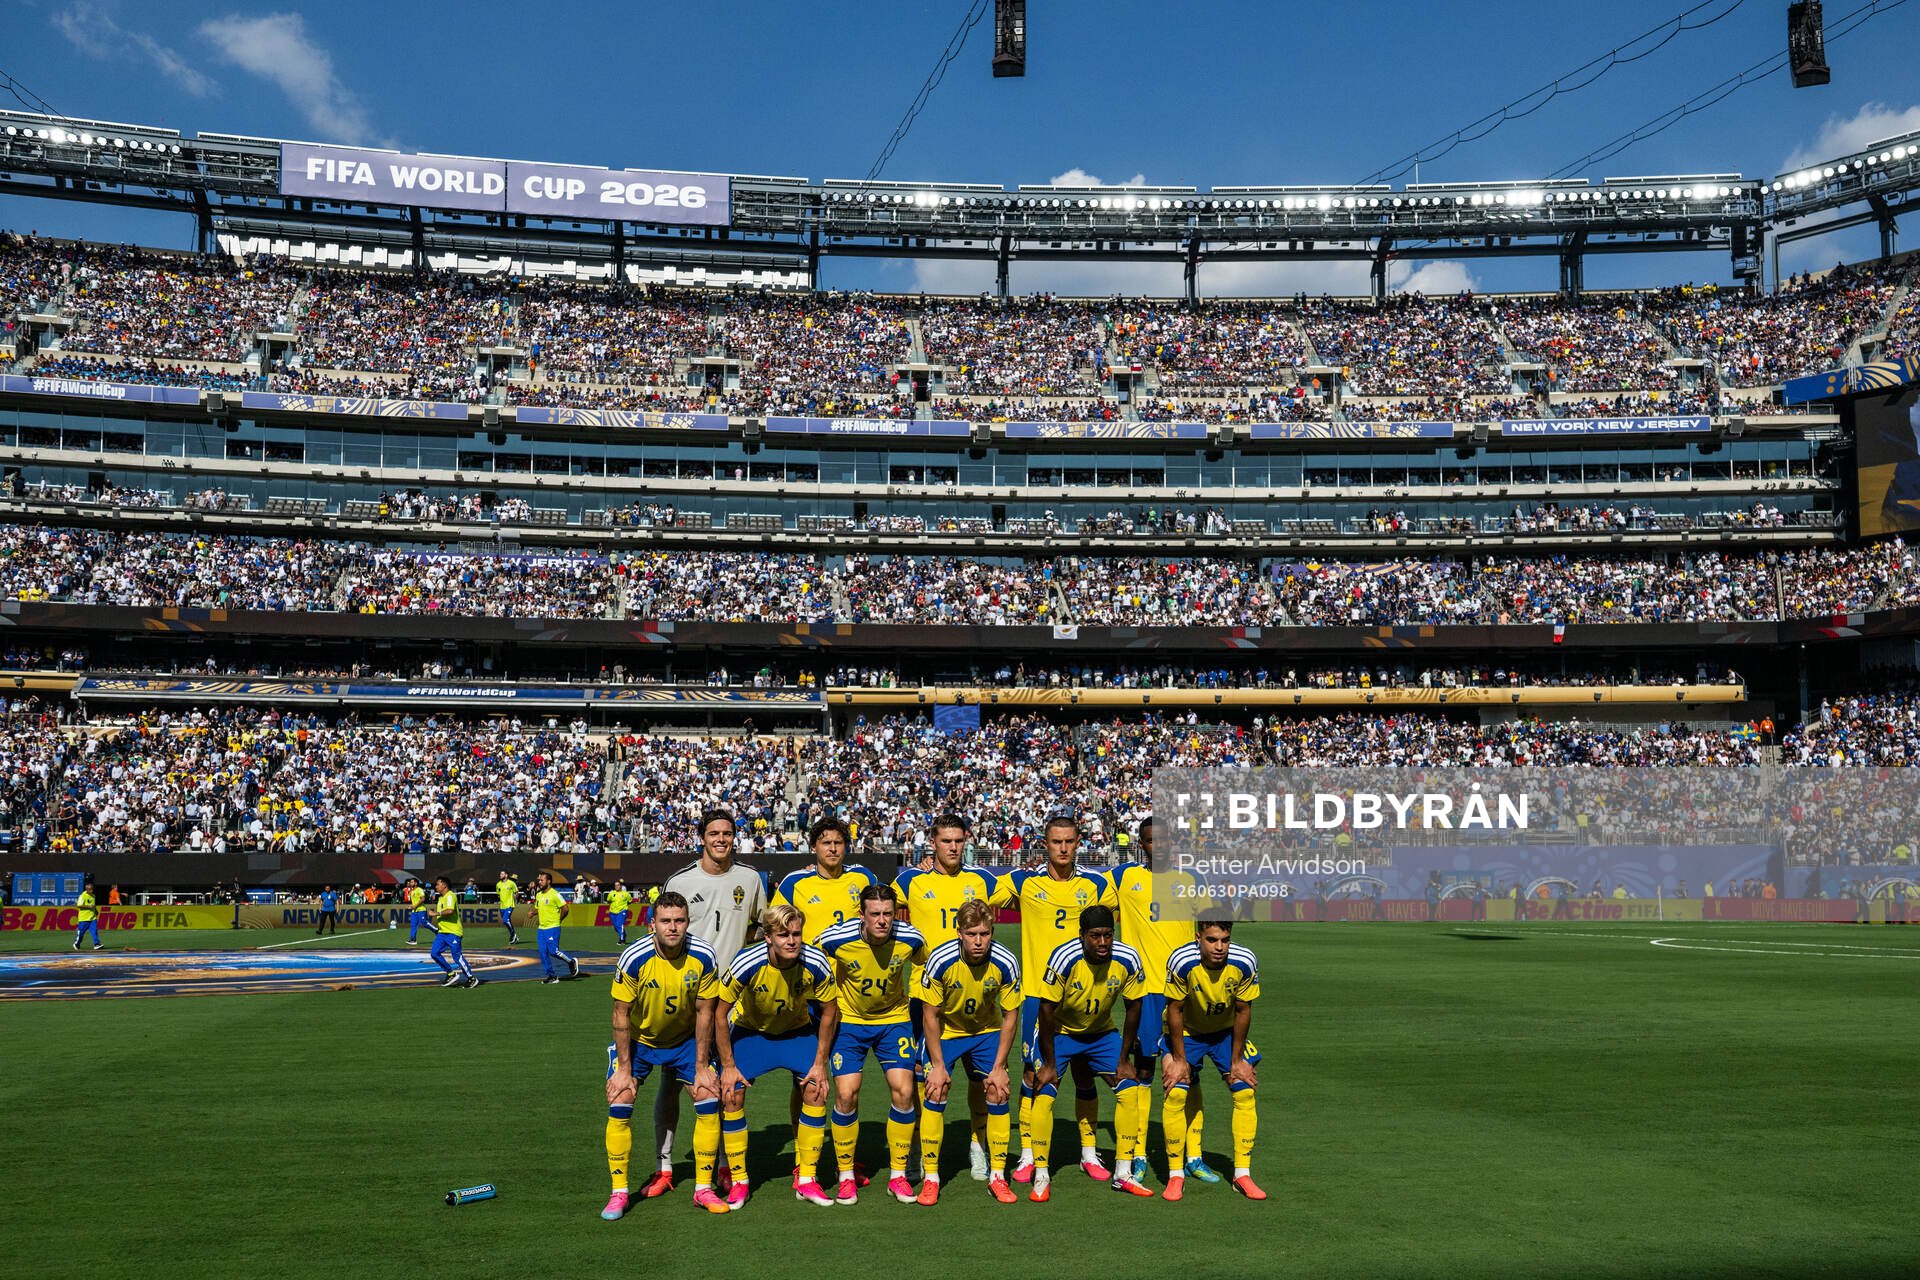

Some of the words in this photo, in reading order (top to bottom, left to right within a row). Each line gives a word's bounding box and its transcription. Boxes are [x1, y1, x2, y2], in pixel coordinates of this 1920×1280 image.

[306, 158, 376, 186] FIFA
[389, 165, 506, 195] WORLD
[523, 175, 586, 201] CUP
[600, 181, 707, 208] 2026
[33, 378, 126, 399] #FIFAWorldCup
[830, 420, 908, 434] #FIFAWorldCup
[1511, 423, 1546, 432] NEW
[1549, 422, 1595, 431] YORK
[1598, 421, 1635, 430] NEW
[1637, 419, 1701, 429] JERSEY
[407, 687, 517, 697] #FIFAWorldCup
[0, 907, 37, 930] Be
[142, 912, 189, 928] FIFA
[714, 910, 721, 932] 1
[833, 910, 844, 926] 3
[1055, 908, 1067, 930] 2
[861, 978, 888, 996] 24
[665, 995, 678, 1015] 5
[774, 999, 786, 1015] 7
[964, 997, 977, 1015] 8
[1085, 998, 1099, 1016] 11
[1205, 1001, 1225, 1016] 18
